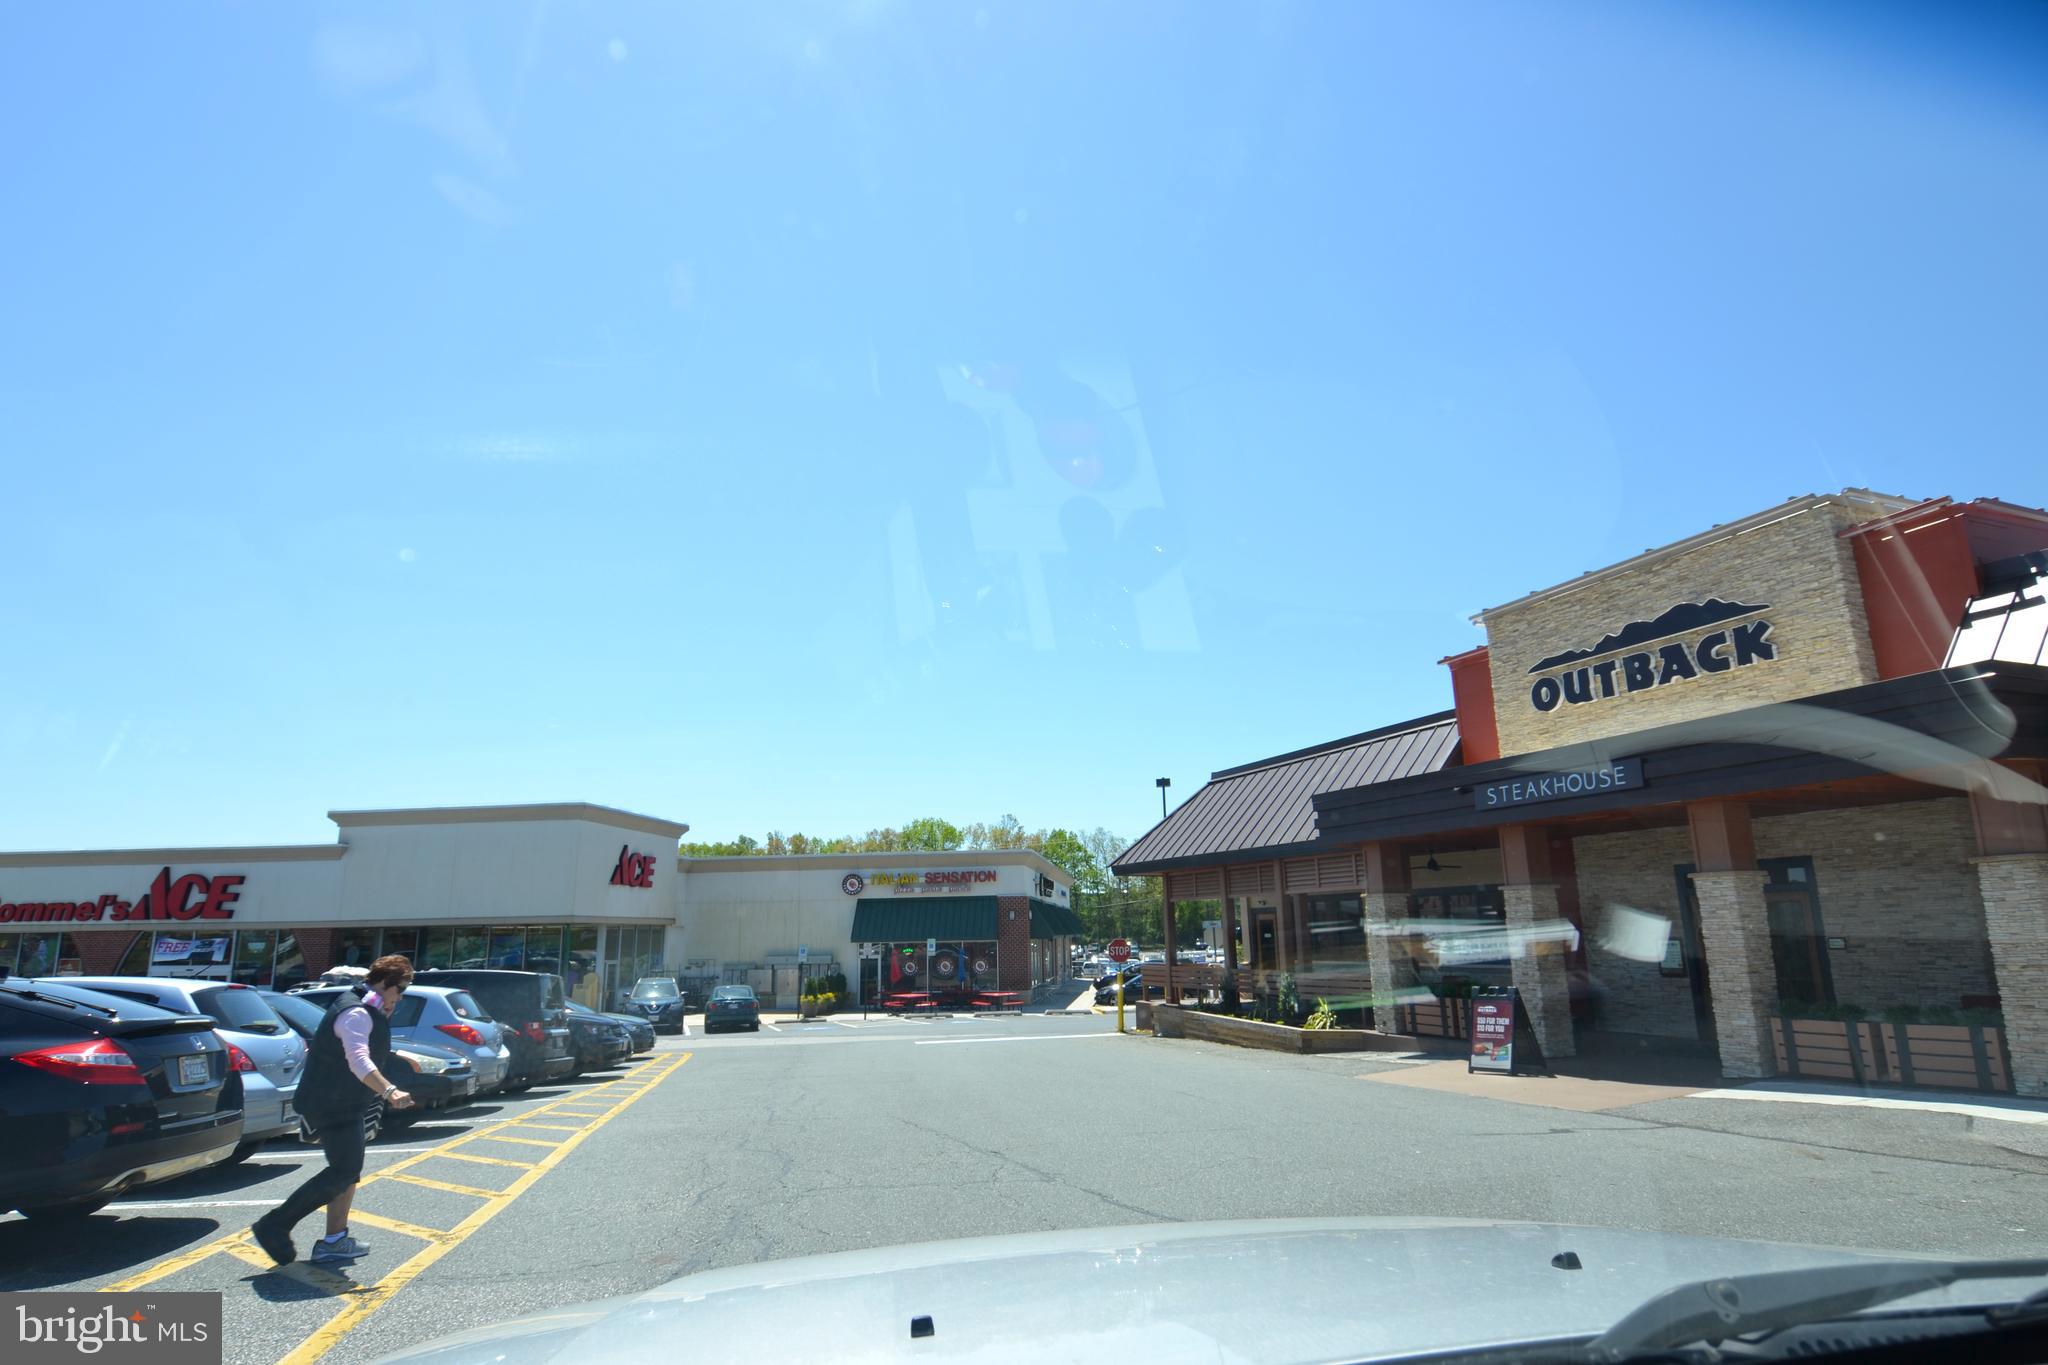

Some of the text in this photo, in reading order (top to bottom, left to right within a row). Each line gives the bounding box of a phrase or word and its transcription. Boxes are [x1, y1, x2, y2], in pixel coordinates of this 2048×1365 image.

[1532, 619, 1777, 712] OUTBACK
[1487, 766, 1627, 805] STEAKHOUSE
[608, 844, 657, 888] ACE
[924, 870, 997, 884] SENSATION
[0, 866, 246, 922] ommel's ACE
[156, 941, 192, 954] FREE
[1109, 946, 1130, 956] STOP
